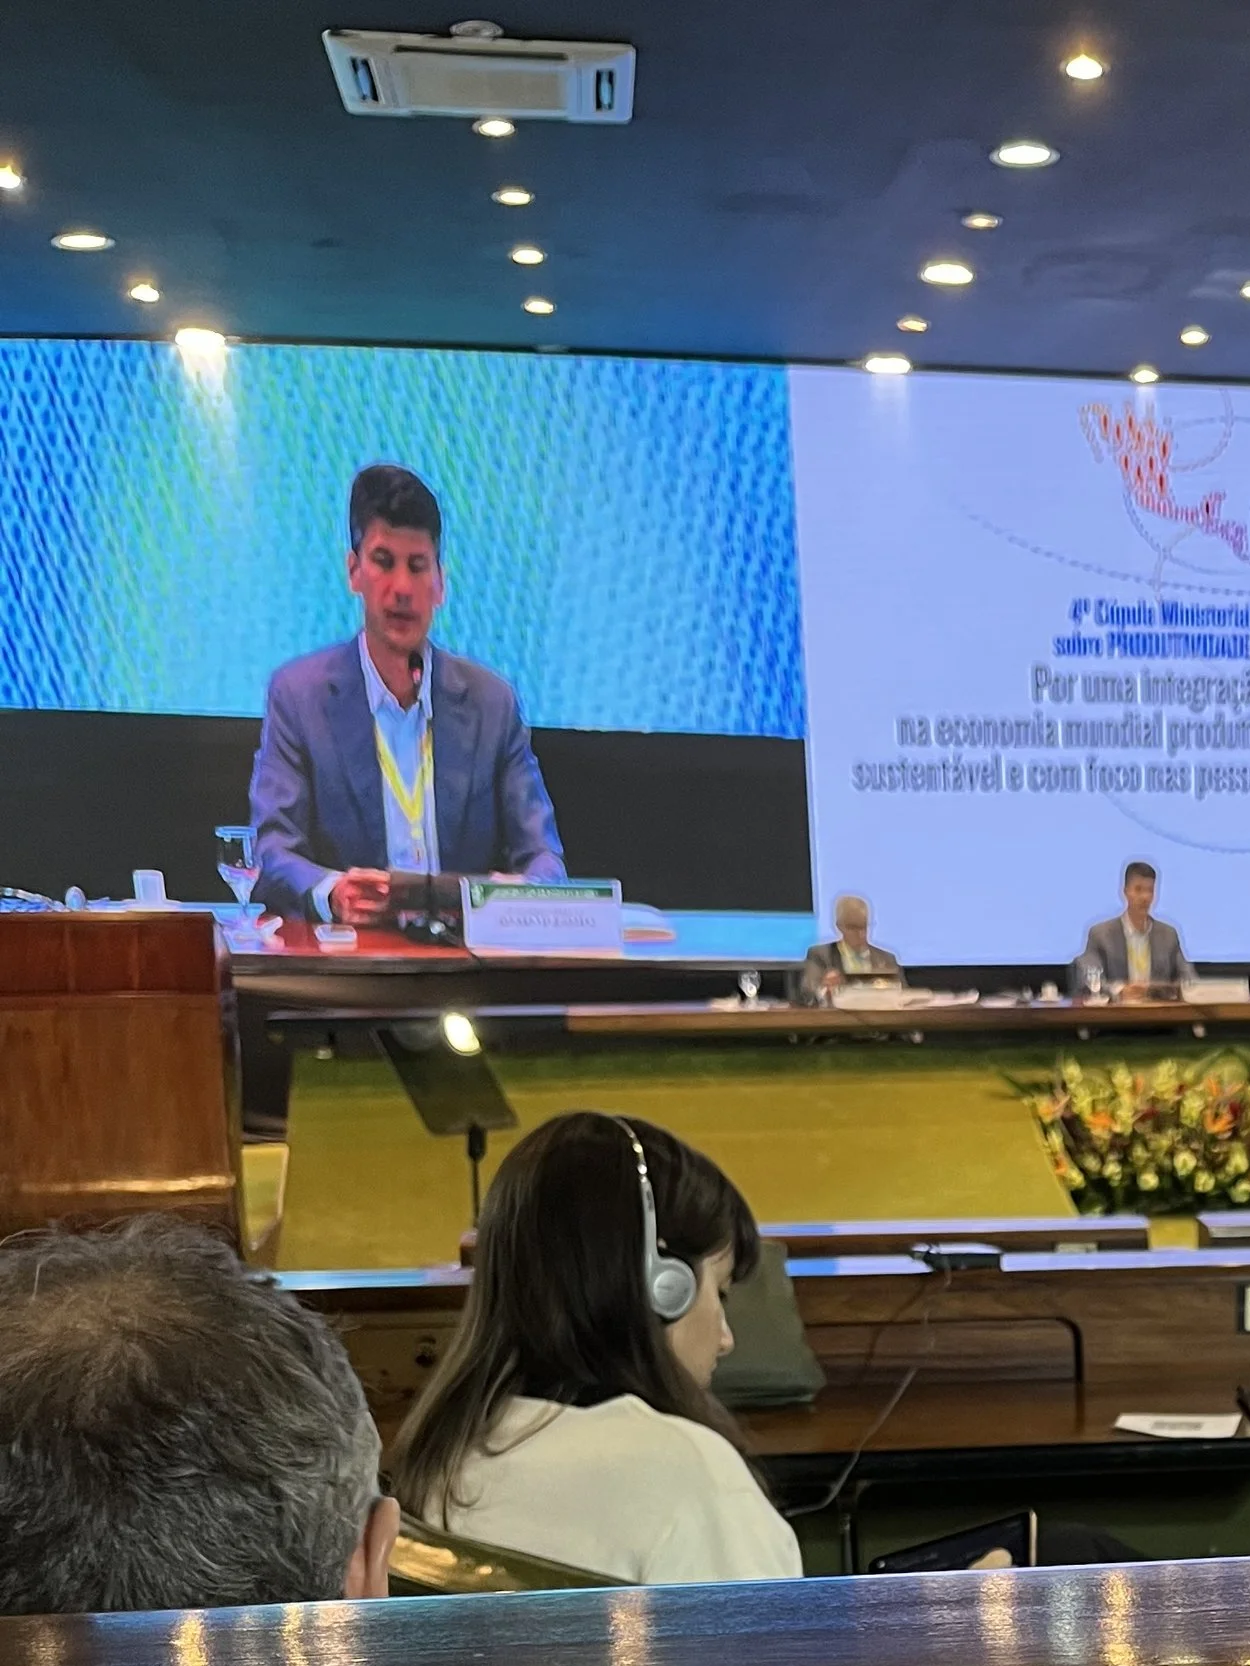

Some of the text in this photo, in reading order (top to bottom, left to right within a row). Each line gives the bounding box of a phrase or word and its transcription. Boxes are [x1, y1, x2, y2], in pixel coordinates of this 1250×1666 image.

[1031, 664, 1078, 702] Por
[1080, 674, 1137, 702] uma
[896, 716, 930, 748] na
[935, 710, 1058, 748] economia
[1062, 711, 1163, 749] mundial
[851, 753, 1001, 792] sustentável
[1006, 763, 1025, 792] e
[1026, 763, 1082, 792] com
[1085, 756, 1142, 792] foco
[1145, 765, 1192, 792] nas
